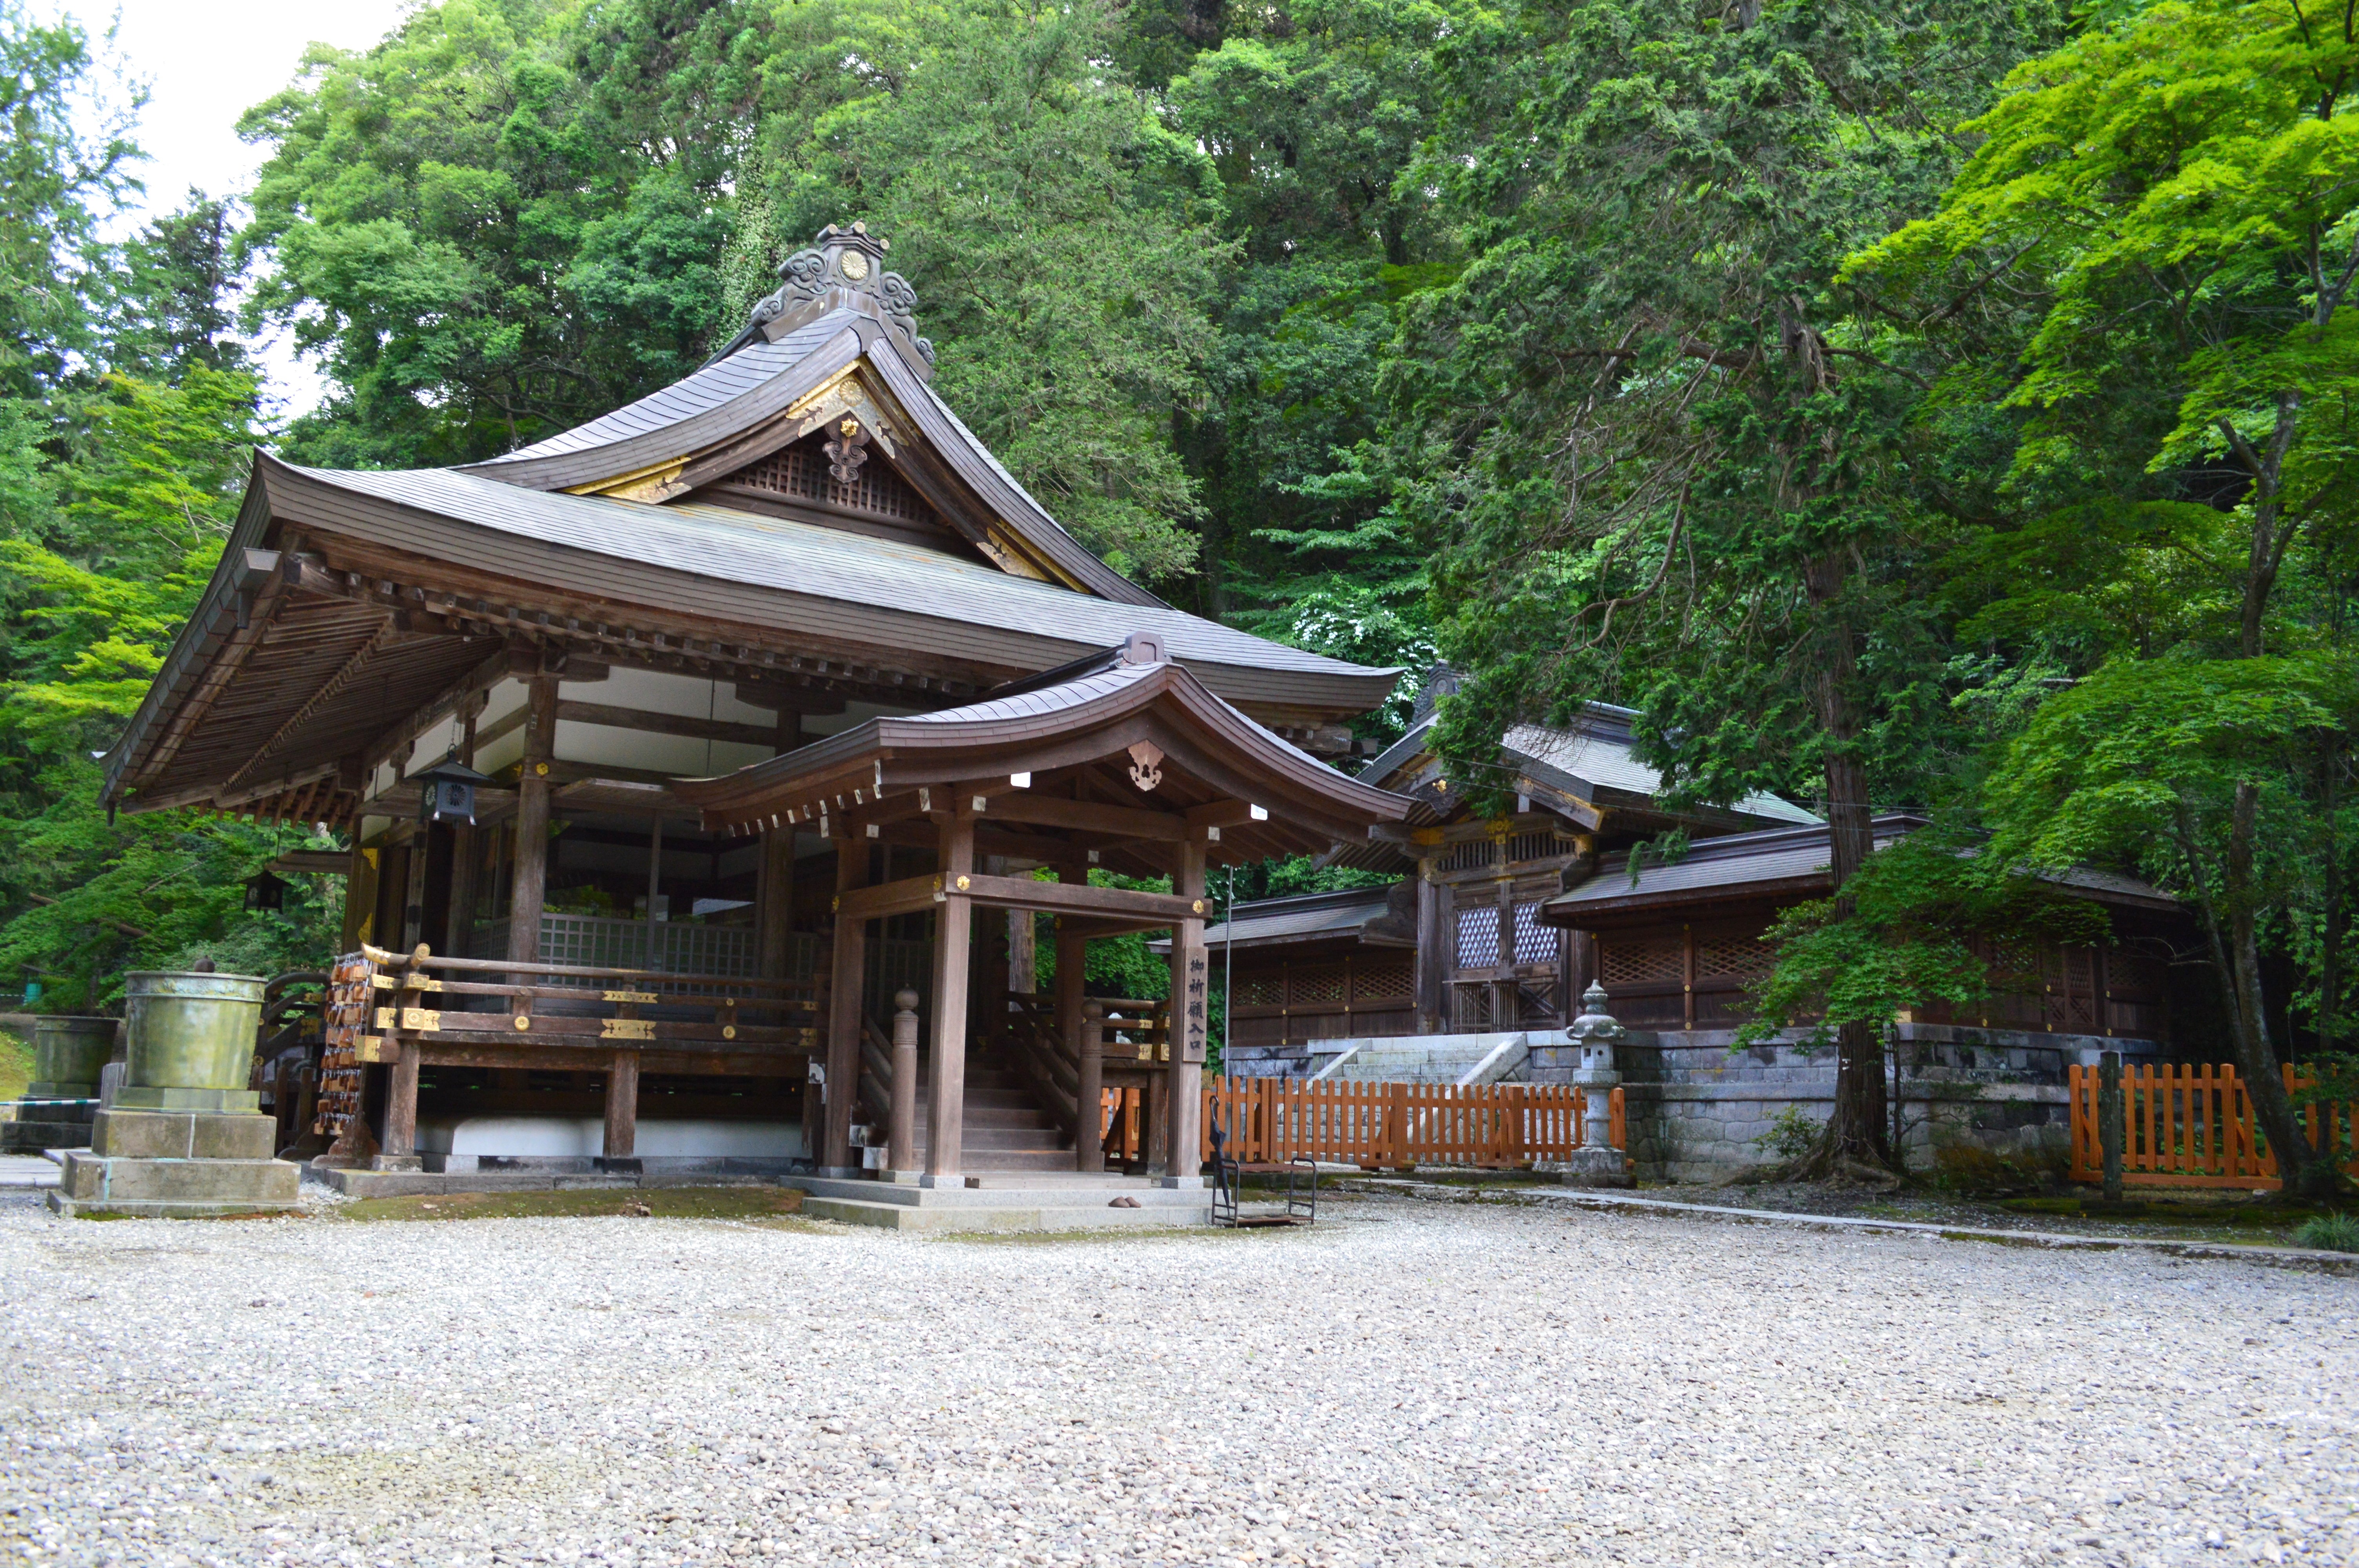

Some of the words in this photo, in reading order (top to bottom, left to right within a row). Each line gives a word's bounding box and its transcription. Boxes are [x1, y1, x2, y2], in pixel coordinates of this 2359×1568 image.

[1188, 959, 1204, 1050] 御祈願入口
